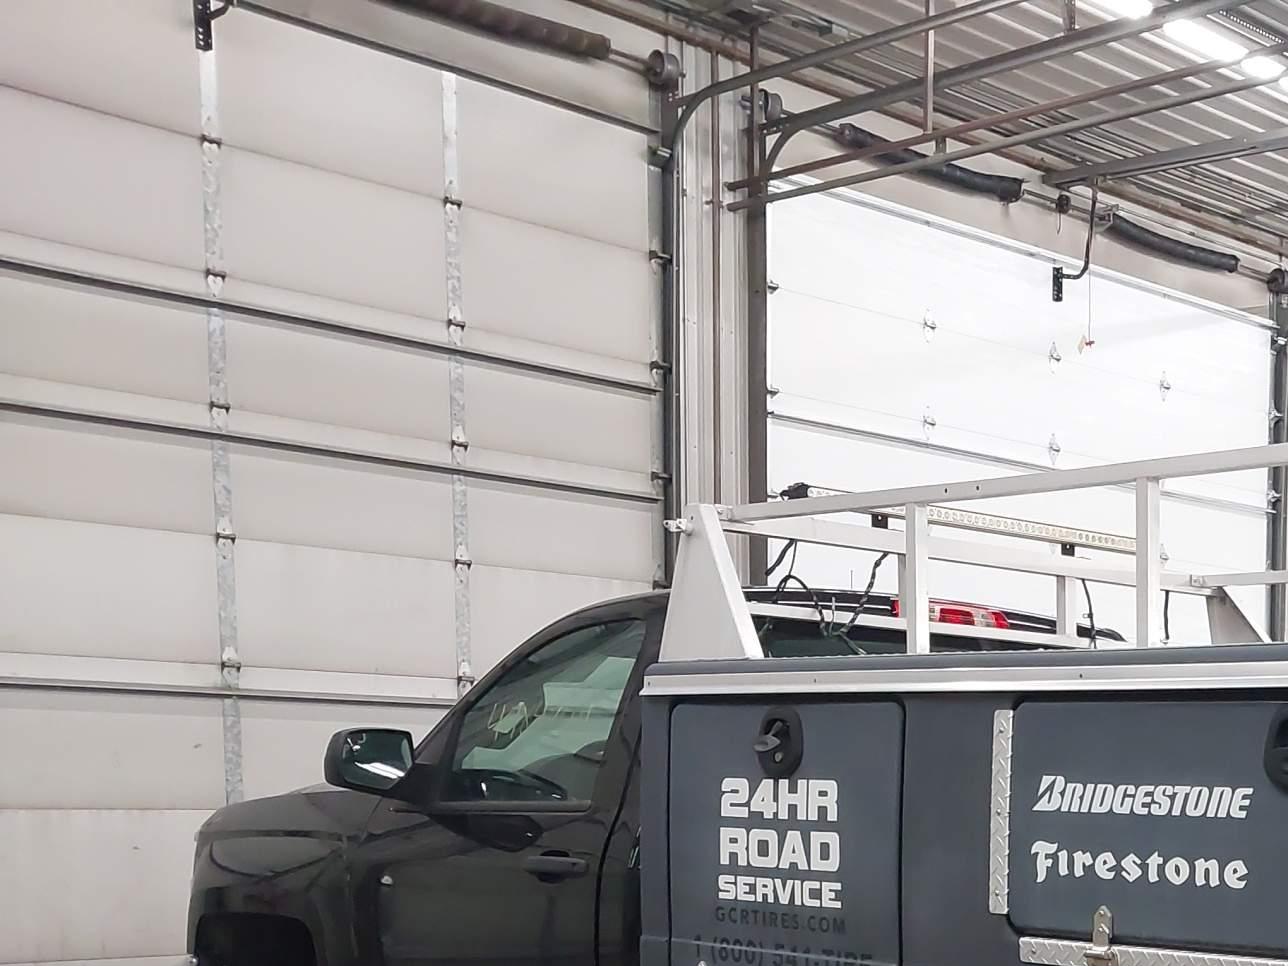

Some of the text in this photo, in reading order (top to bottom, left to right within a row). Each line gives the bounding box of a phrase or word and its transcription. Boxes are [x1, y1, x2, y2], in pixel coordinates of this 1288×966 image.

[720, 778, 838, 821] 24HR
[1032, 775, 1254, 818] BRIDGESTONE
[720, 828, 840, 872] ROAD
[1031, 840, 1249, 889] Firestone
[718, 875, 842, 908] SERVICE
[715, 907, 846, 934] GCRTIRES.COM
